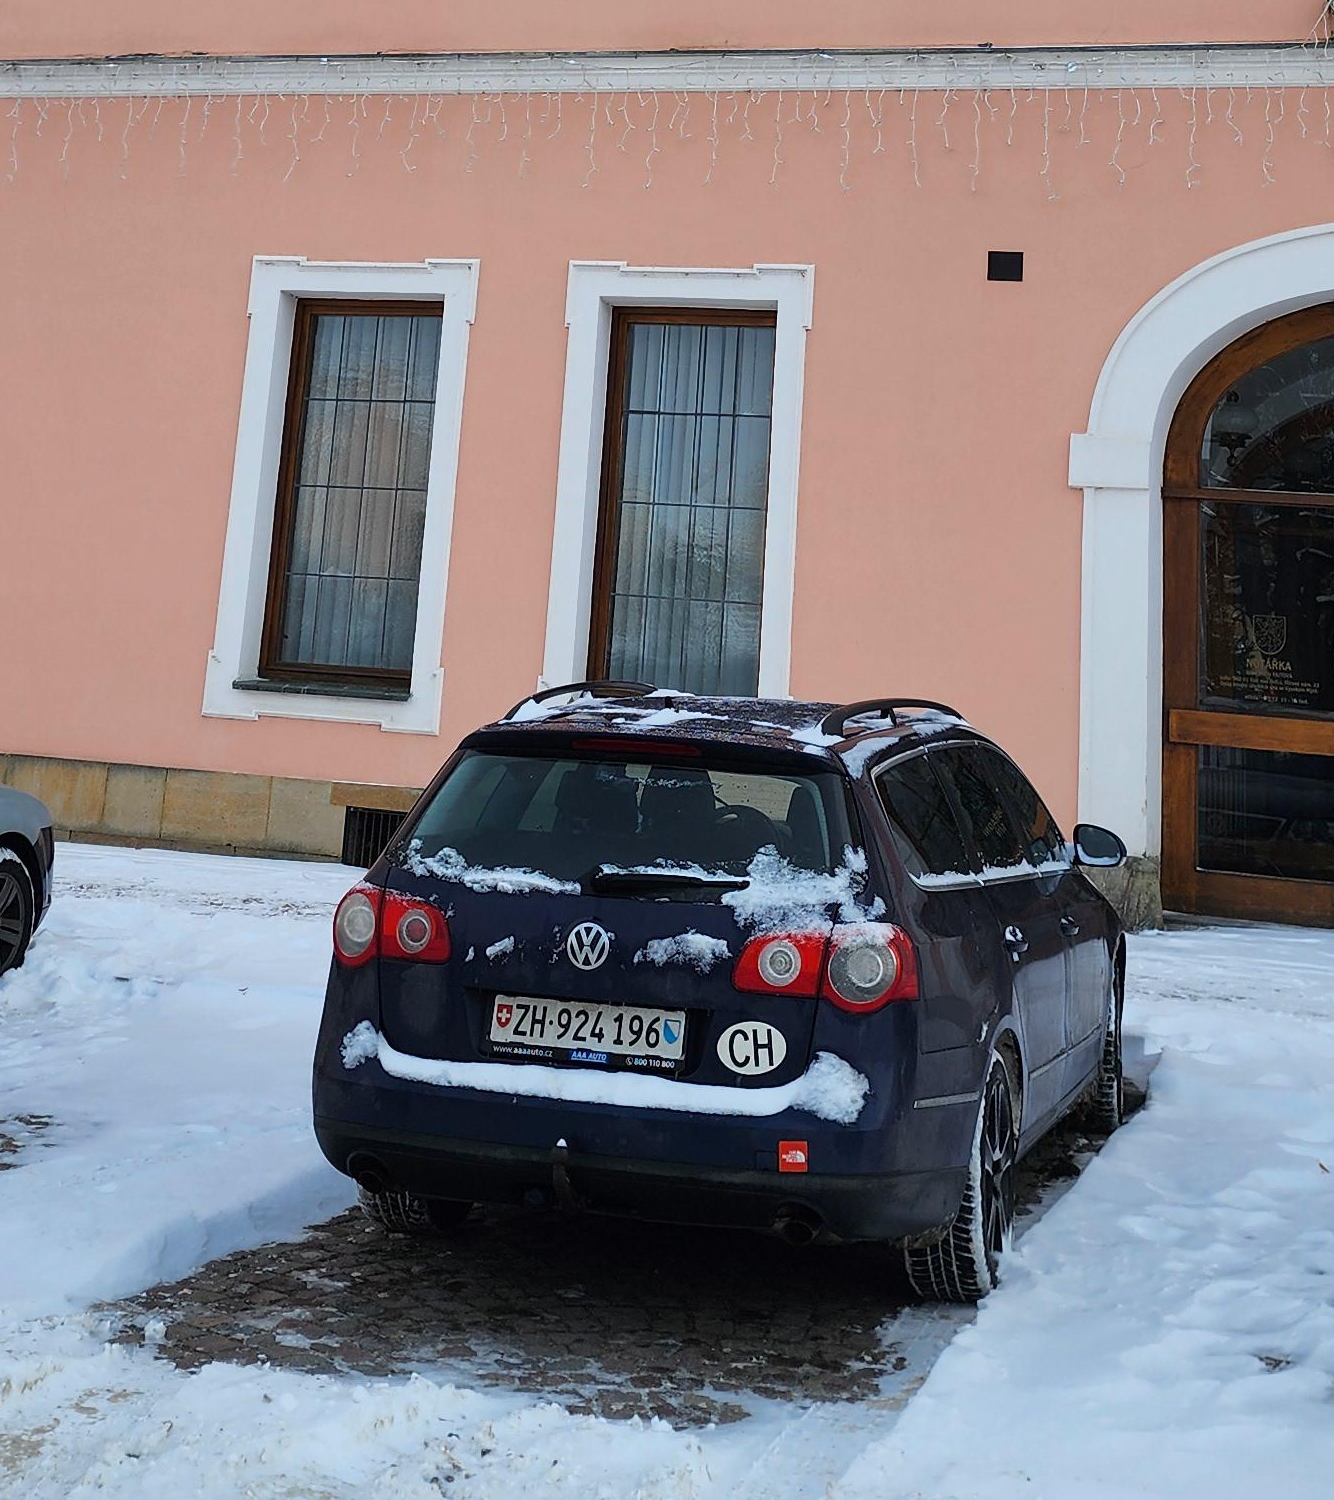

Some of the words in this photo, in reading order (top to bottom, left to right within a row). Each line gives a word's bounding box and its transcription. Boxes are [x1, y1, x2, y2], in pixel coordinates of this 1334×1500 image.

[571, 1051, 587, 1060] AAA
[588, 1053, 607, 1062] AUTO
[728, 1028, 775, 1069] CH
